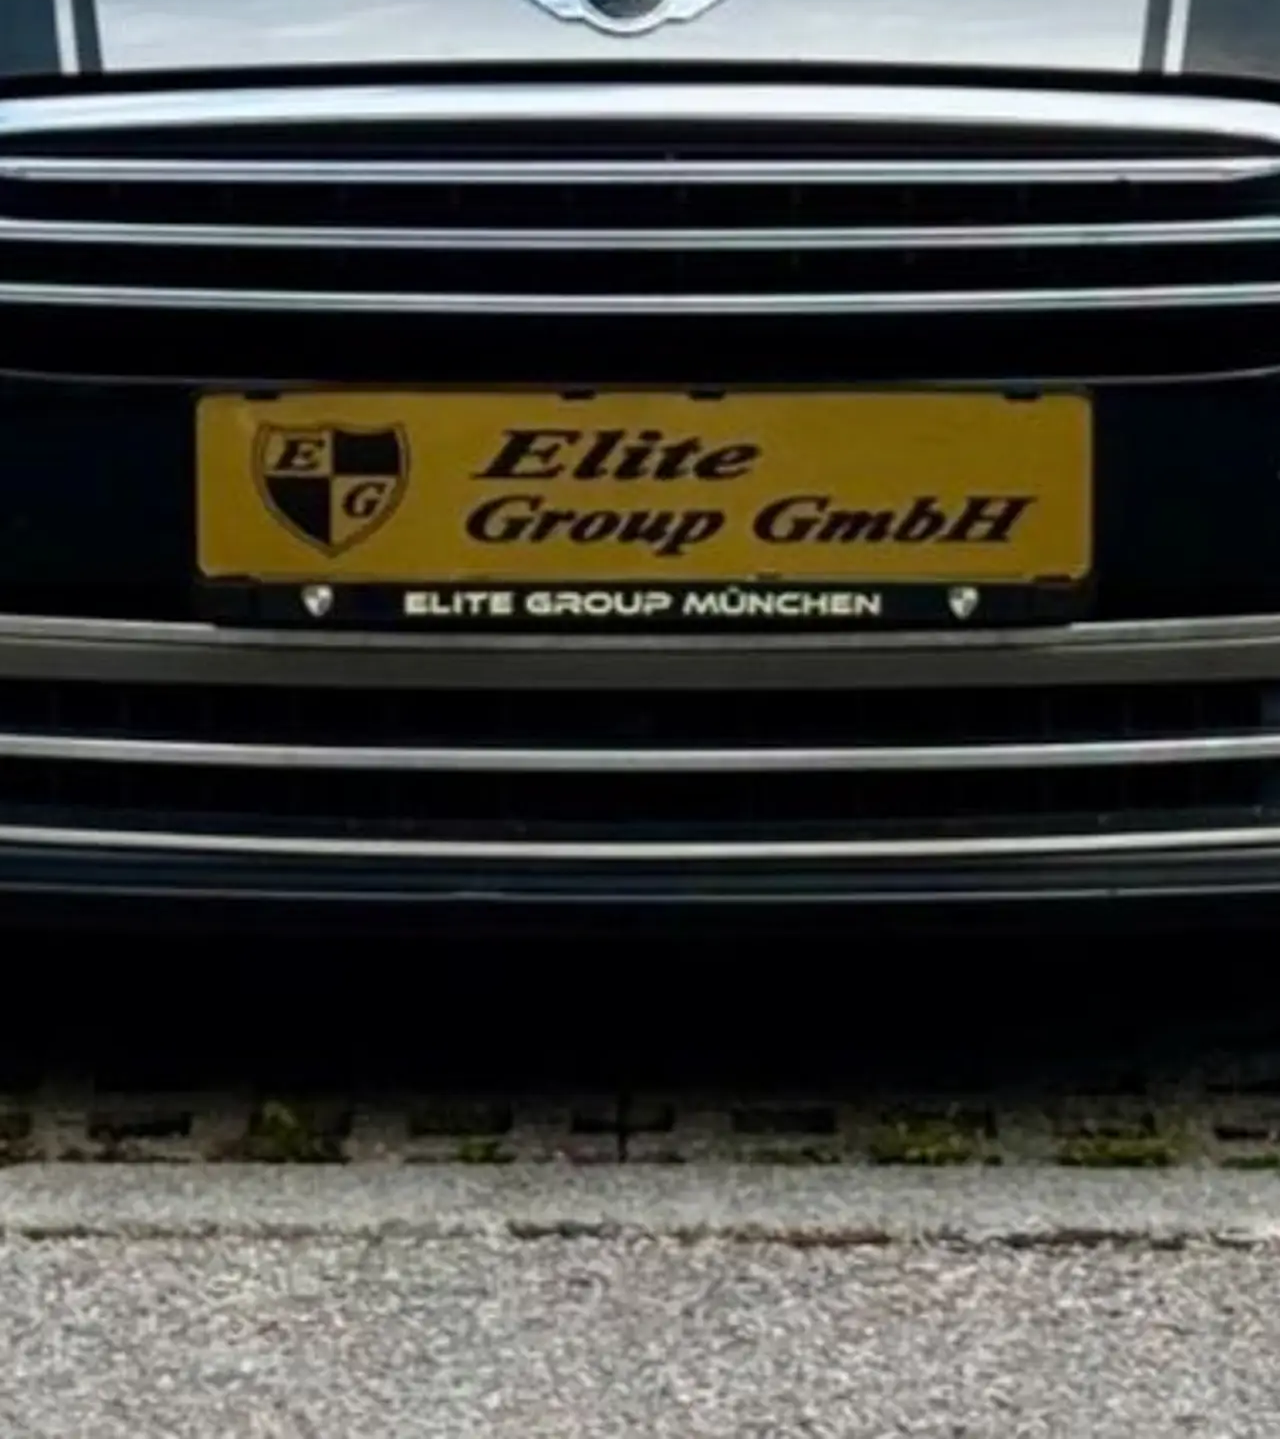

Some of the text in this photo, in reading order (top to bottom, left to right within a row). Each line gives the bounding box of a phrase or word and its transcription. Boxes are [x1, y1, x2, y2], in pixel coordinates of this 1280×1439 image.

[274, 439, 326, 471] E
[471, 429, 762, 480] Elite
[342, 480, 388, 519] G
[465, 494, 1038, 556] Group GmbH
[404, 586, 881, 615] ELITE GROUP MÜNCHEN
